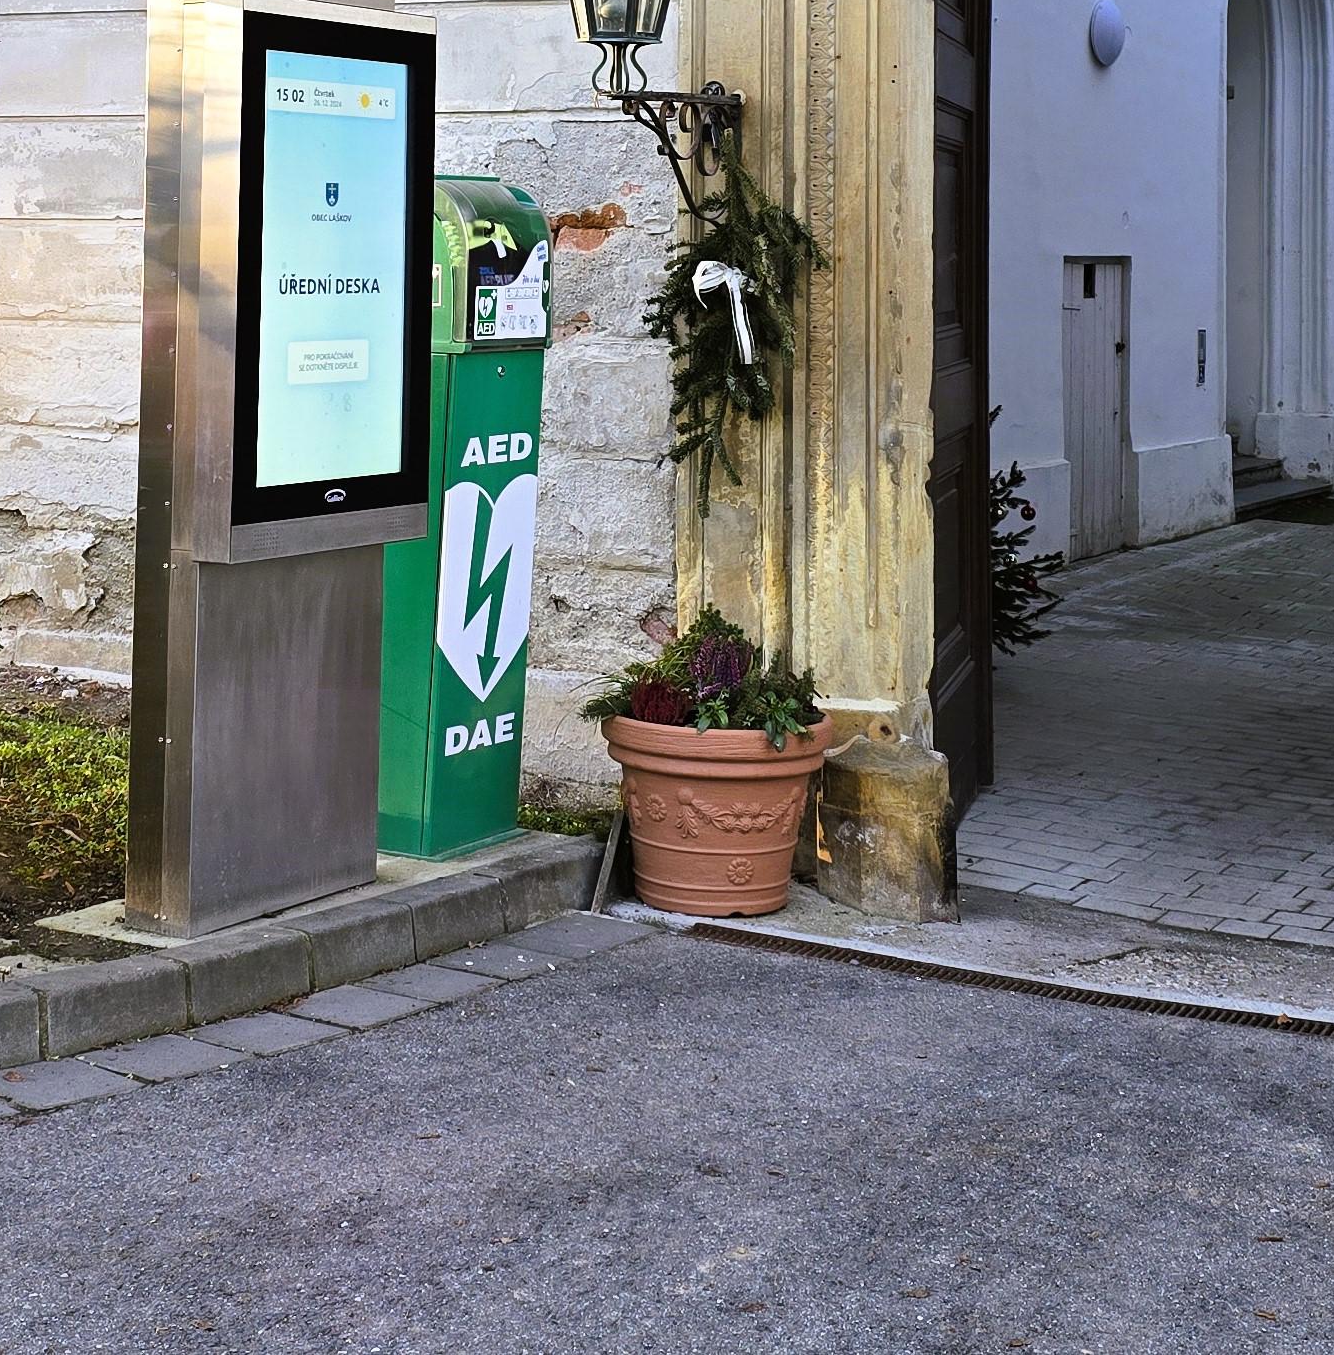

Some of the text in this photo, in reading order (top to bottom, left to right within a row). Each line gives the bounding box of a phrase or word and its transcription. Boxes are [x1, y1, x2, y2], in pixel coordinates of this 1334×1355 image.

[311, 212, 352, 222] OBEC LAŠKOV
[278, 273, 381, 295] ÚŘEDNÍ DESKA
[476, 322, 496, 336] AED
[460, 432, 533, 468] AED
[444, 712, 516, 758] DAE
